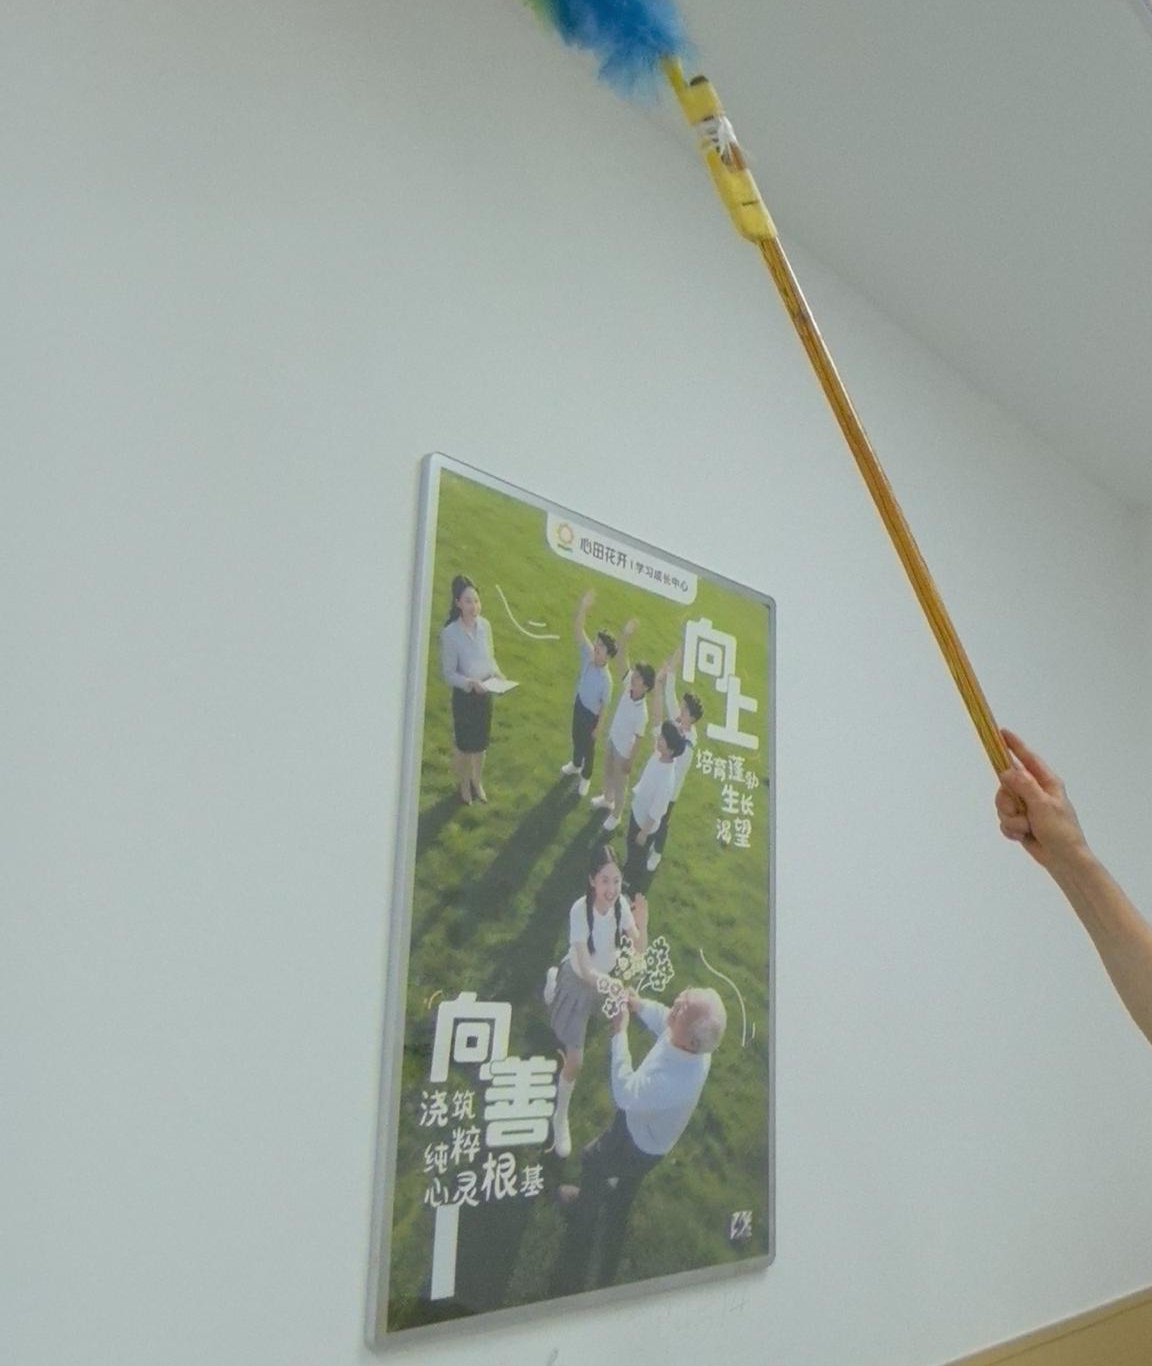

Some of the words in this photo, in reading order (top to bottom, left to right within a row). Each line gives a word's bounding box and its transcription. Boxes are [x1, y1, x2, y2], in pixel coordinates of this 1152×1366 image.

[580, 537, 628, 569] 心田花开
[635, 561, 689, 593] 学习成长中心
[682, 617, 760, 750] 向上
[696, 748, 760, 789] 培育蓬勃
[721, 784, 755, 816] 生长
[716, 817, 752, 848] 渴望
[430, 991, 558, 1147] 向善
[419, 1089, 477, 1128] 浇筑
[423, 1126, 481, 1175] 纯粹
[424, 1151, 545, 1208] 心灵根基
